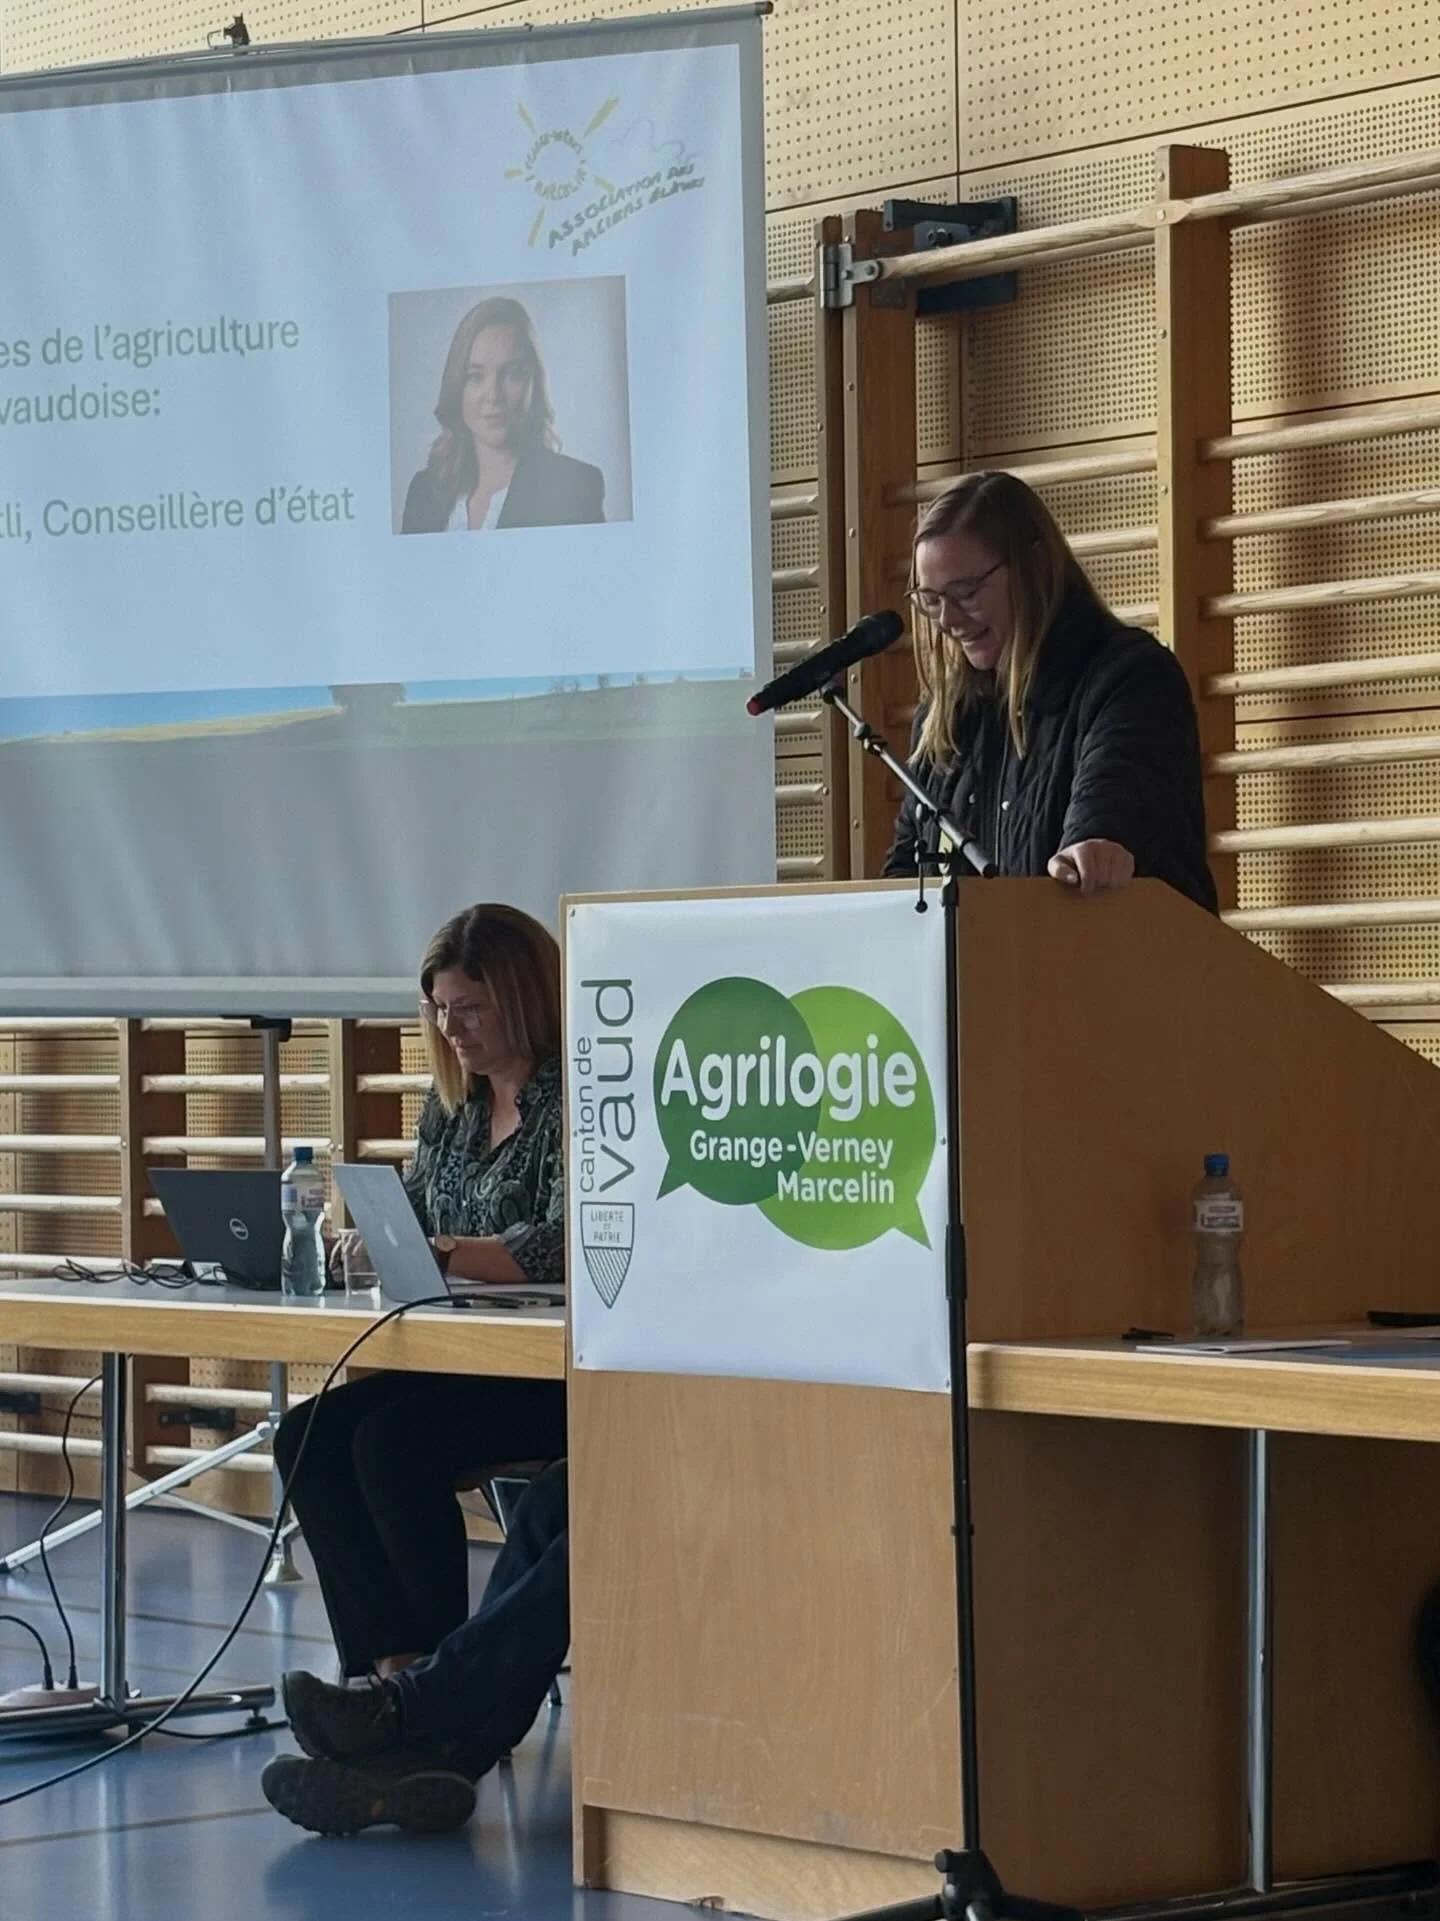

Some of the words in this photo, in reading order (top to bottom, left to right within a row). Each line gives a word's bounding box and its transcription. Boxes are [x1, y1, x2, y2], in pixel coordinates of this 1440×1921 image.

[548, 171, 662, 249] ASSOCIATION
[41, 327, 85, 366] de
[0, 383, 162, 426] vaudoise:
[43, 490, 245, 537] Conseillère
[573, 1036, 592, 1076] de
[660, 1034, 917, 1121] Agrilogie
[580, 979, 636, 1193] vaud
[579, 1084, 596, 1193] canton
[777, 1170, 895, 1204] Marcelin
